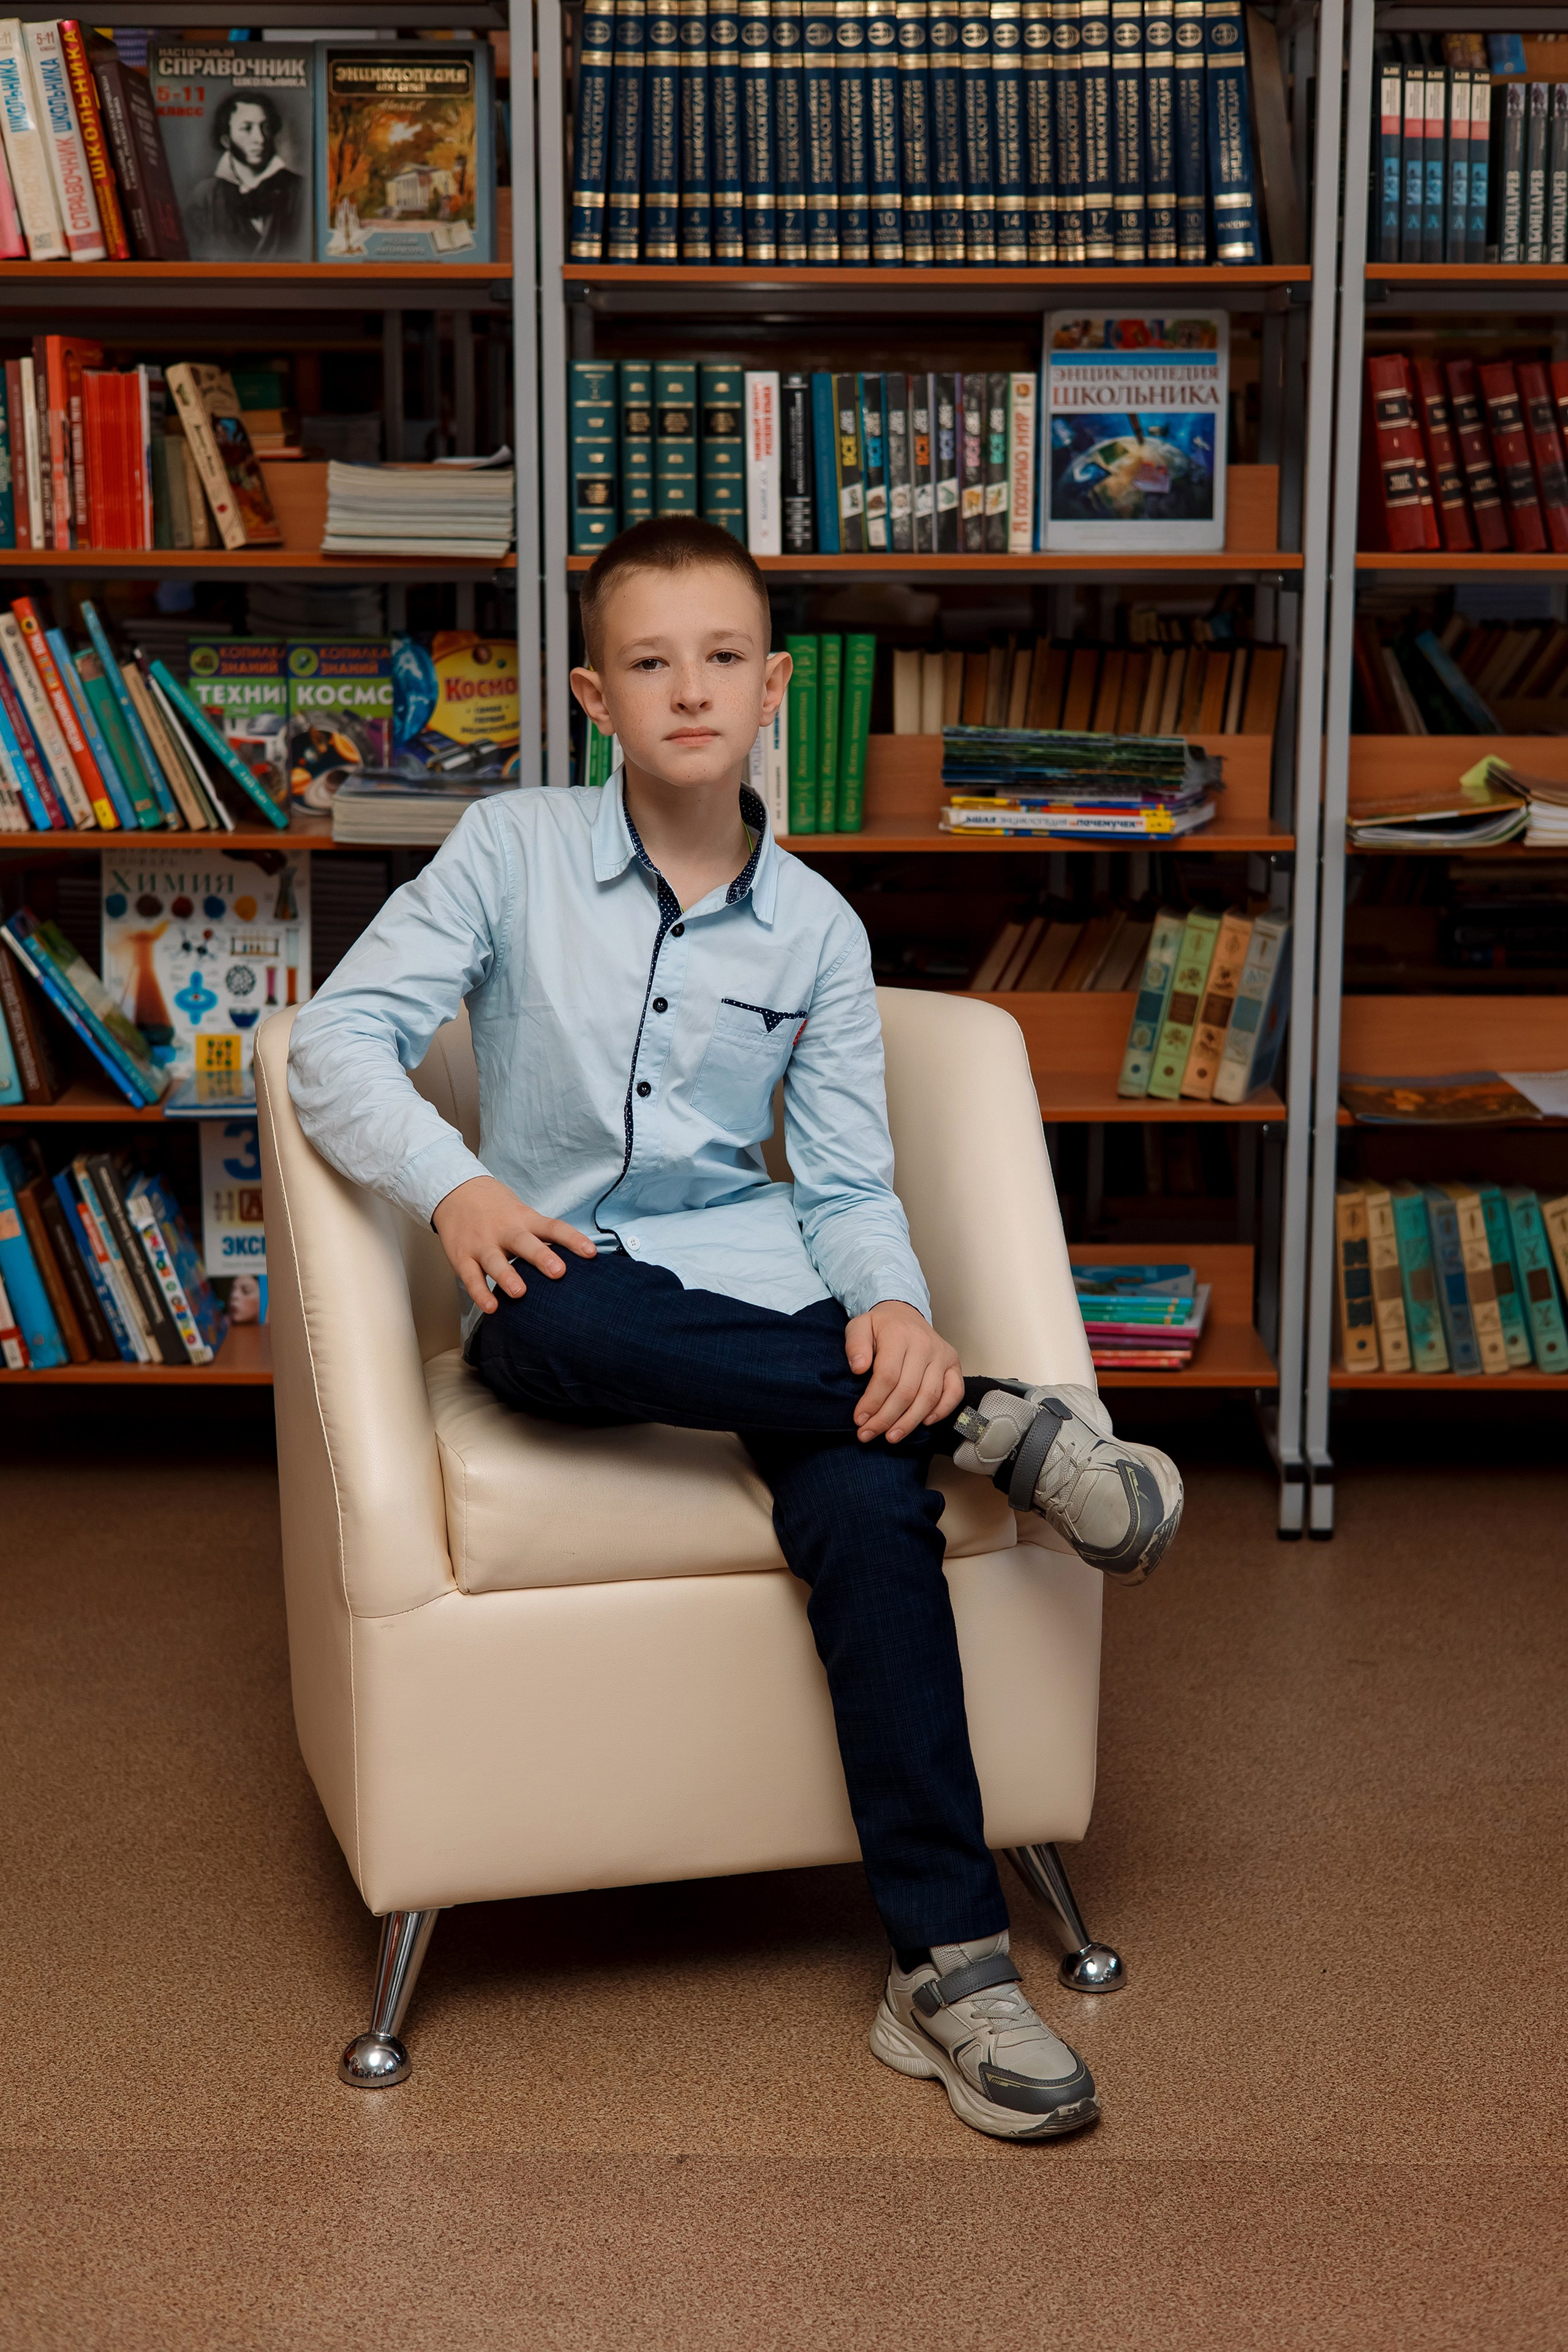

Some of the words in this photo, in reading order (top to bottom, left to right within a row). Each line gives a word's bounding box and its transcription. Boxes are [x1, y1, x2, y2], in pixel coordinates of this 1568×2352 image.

[159, 58, 305, 76] СПРАВОЧНИК
[336, 67, 467, 83] ЭНЦИКЛОПЕДИЯ
[1, 58, 29, 133] ШКОЛЬНИКА
[40, 58, 72, 133] ШКОЛЬНИКА
[64, 29, 108, 179] ШКОЛЬНИКА
[157, 86, 205, 102] 5-11
[590, 77, 605, 181] ЭНЦИКЛОПЕДИЯ
[661, 77, 674, 181] ЭНЦИКЛОПЕДИЯ
[692, 77, 705, 181] ЭНЦИКЛОПЕДИЯ
[723, 77, 738, 181] ЭНЦИКЛОПЕДИЯ
[755, 78, 769, 183] ЭНЦИКЛОПЕДИЯ
[786, 78, 799, 183] ЭНЦИКЛОПЕДИЯ
[818, 78, 833, 183] ЭНЦИКЛОПЕДИЯ
[850, 78, 864, 183] ЭНЦИКЛОПЕДИЯ
[881, 78, 895, 183] ЭНЦИКЛОПЕДИЯ
[912, 80, 927, 184] ЭНЦИКЛОПЕДИЯ
[975, 78, 990, 184] ЭНЦИКЛОПЕДИЯ
[1006, 80, 1020, 184] ЭНЦИКЛОПЕДИЯ
[1037, 80, 1051, 184] ЭНЦИКЛОПЕДИЯ
[1066, 80, 1080, 184] ЭНЦИКЛОПЕДИЯ
[1095, 77, 1109, 183] ЭНЦИКЛОПЕДИЯ
[1126, 78, 1139, 183] ЭНЦИКЛОПЕДИЯ
[1158, 77, 1172, 183] ЭНЦИКЛОПЕДИЯ
[1226, 78, 1243, 183] ЭНЦИКЛОПЕДИЯ
[56, 135, 91, 230] СПРАВОЧНИК
[582, 209, 592, 224] 1
[618, 209, 630, 225] 2
[657, 210, 667, 225] 3
[690, 211, 701, 225] 4
[723, 209, 733, 225] 5
[877, 211, 896, 226] 10
[1090, 210, 1109, 226] 17
[1504, 170, 1520, 244] БОНДАРЕВ
[1529, 170, 1544, 244] БОНДАРЕВ
[1551, 170, 1567, 244] БОНДАРЕВ
[754, 212, 766, 227] 6
[785, 212, 795, 227] 7
[817, 212, 829, 227] 8
[908, 213, 925, 228] 11
[941, 212, 959, 227] 12
[972, 213, 990, 228] 13
[1002, 213, 1021, 228] 14
[1033, 213, 1052, 228] 15
[1061, 213, 1080, 228] 16
[1120, 212, 1139, 227] 18
[1153, 211, 1171, 227] 19
[1052, 366, 1219, 383] ЭНЦИКЛОПЕДИЯ
[1052, 384, 1221, 407] ШКОЛЬНИКА
[1014, 412, 1029, 447] МИР
[1014, 450, 1029, 518] ПОЗНАЮ
[1012, 521, 1028, 533] Я
[320, 647, 391, 659] КОПИЛКА
[221, 662, 279, 674] ЗНАНИЙ
[321, 662, 379, 674] ЗНАНИЙ
[110, 869, 233, 893] ХИМИЯ
[222, 1235, 266, 1256] ЭКС
